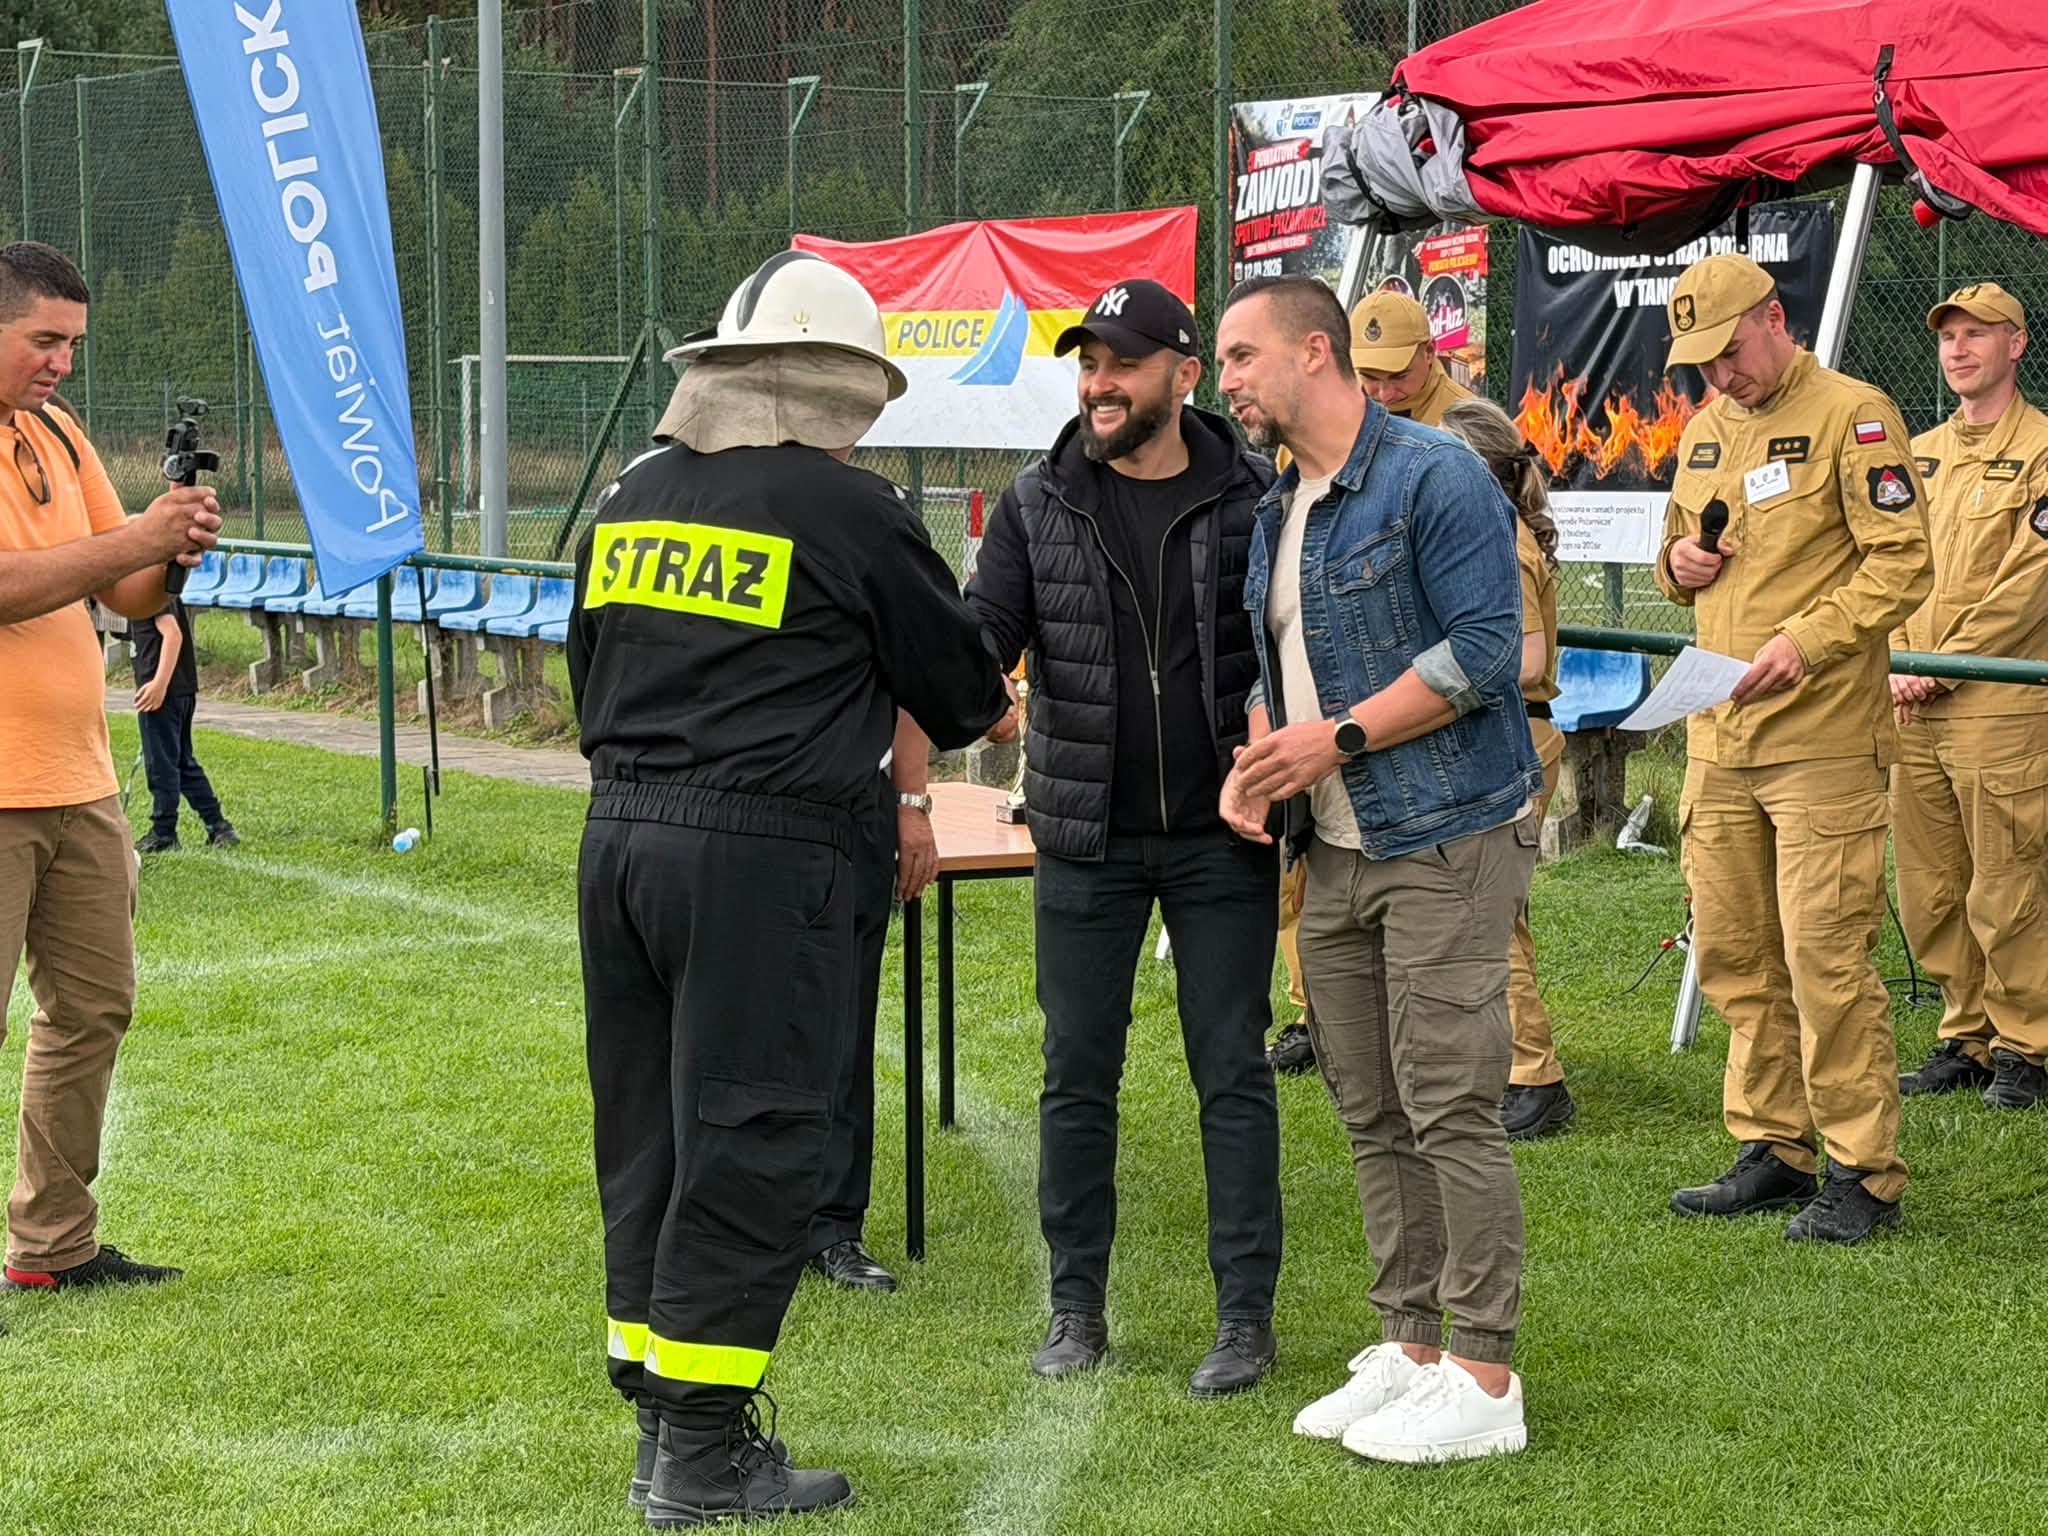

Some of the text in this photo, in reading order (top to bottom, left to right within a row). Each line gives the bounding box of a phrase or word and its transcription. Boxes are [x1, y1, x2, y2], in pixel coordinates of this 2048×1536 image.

[1710, 233, 1788, 262] PORNA
[1095, 287, 1130, 316] NY
[1614, 279, 1634, 308] W
[897, 318, 985, 349] POLICE
[1615, 505, 1645, 517] projektu
